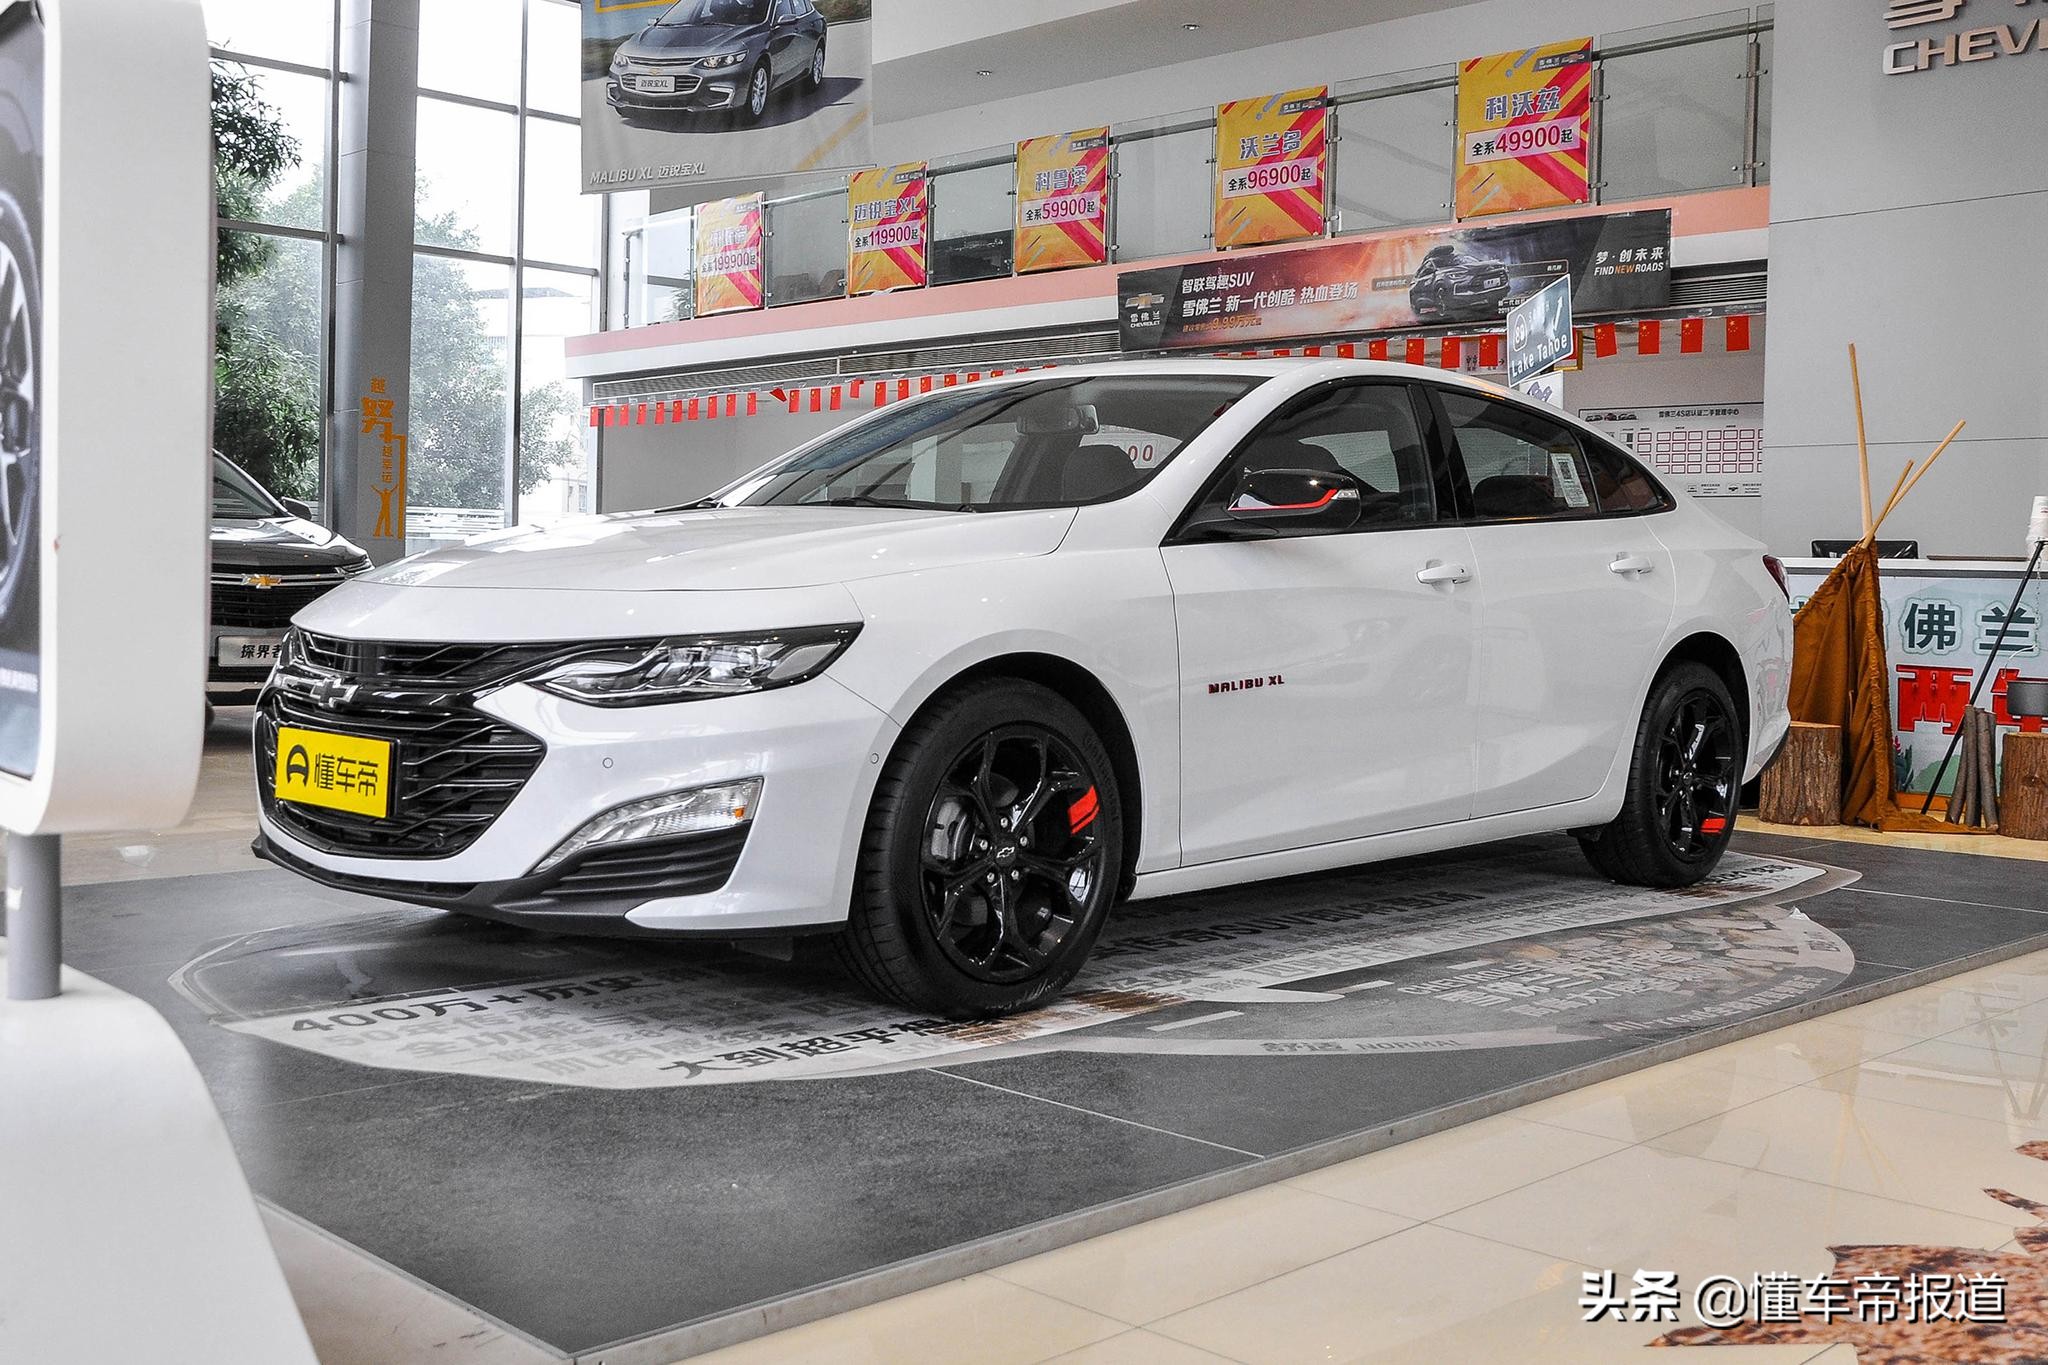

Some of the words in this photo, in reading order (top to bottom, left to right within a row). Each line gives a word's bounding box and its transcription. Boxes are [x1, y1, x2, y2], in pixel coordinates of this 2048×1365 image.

[1883, 18, 2048, 75] CHEV
[1485, 86, 1560, 120] 科沃兹
[1240, 130, 1302, 160] 沃兰多
[1472, 125, 1573, 157] 全系49900起
[590, 167, 636, 185] MALIBU
[639, 167, 654, 180] XL
[1035, 166, 1088, 192] 科鲁泽
[1228, 164, 1311, 192] 全系96900起
[1025, 197, 1096, 221] 全系59900起
[855, 225, 919, 248] 全系119900起
[1593, 266, 1614, 276] FIND
[1615, 264, 1635, 275] NEW
[1635, 262, 1664, 273] ROADS
[1182, 272, 1255, 294] 智联驾趣SUV
[1182, 296, 1222, 318] 雪佛兰
[1299, 281, 1359, 305] 热血登场
[1511, 353, 1535, 377] Lake
[1537, 334, 1568, 362] Tahoe
[1209, 677, 1264, 694] MALIBU
[1268, 675, 1285, 686] XL
[1354, 1038, 1471, 1051] NORMAL
